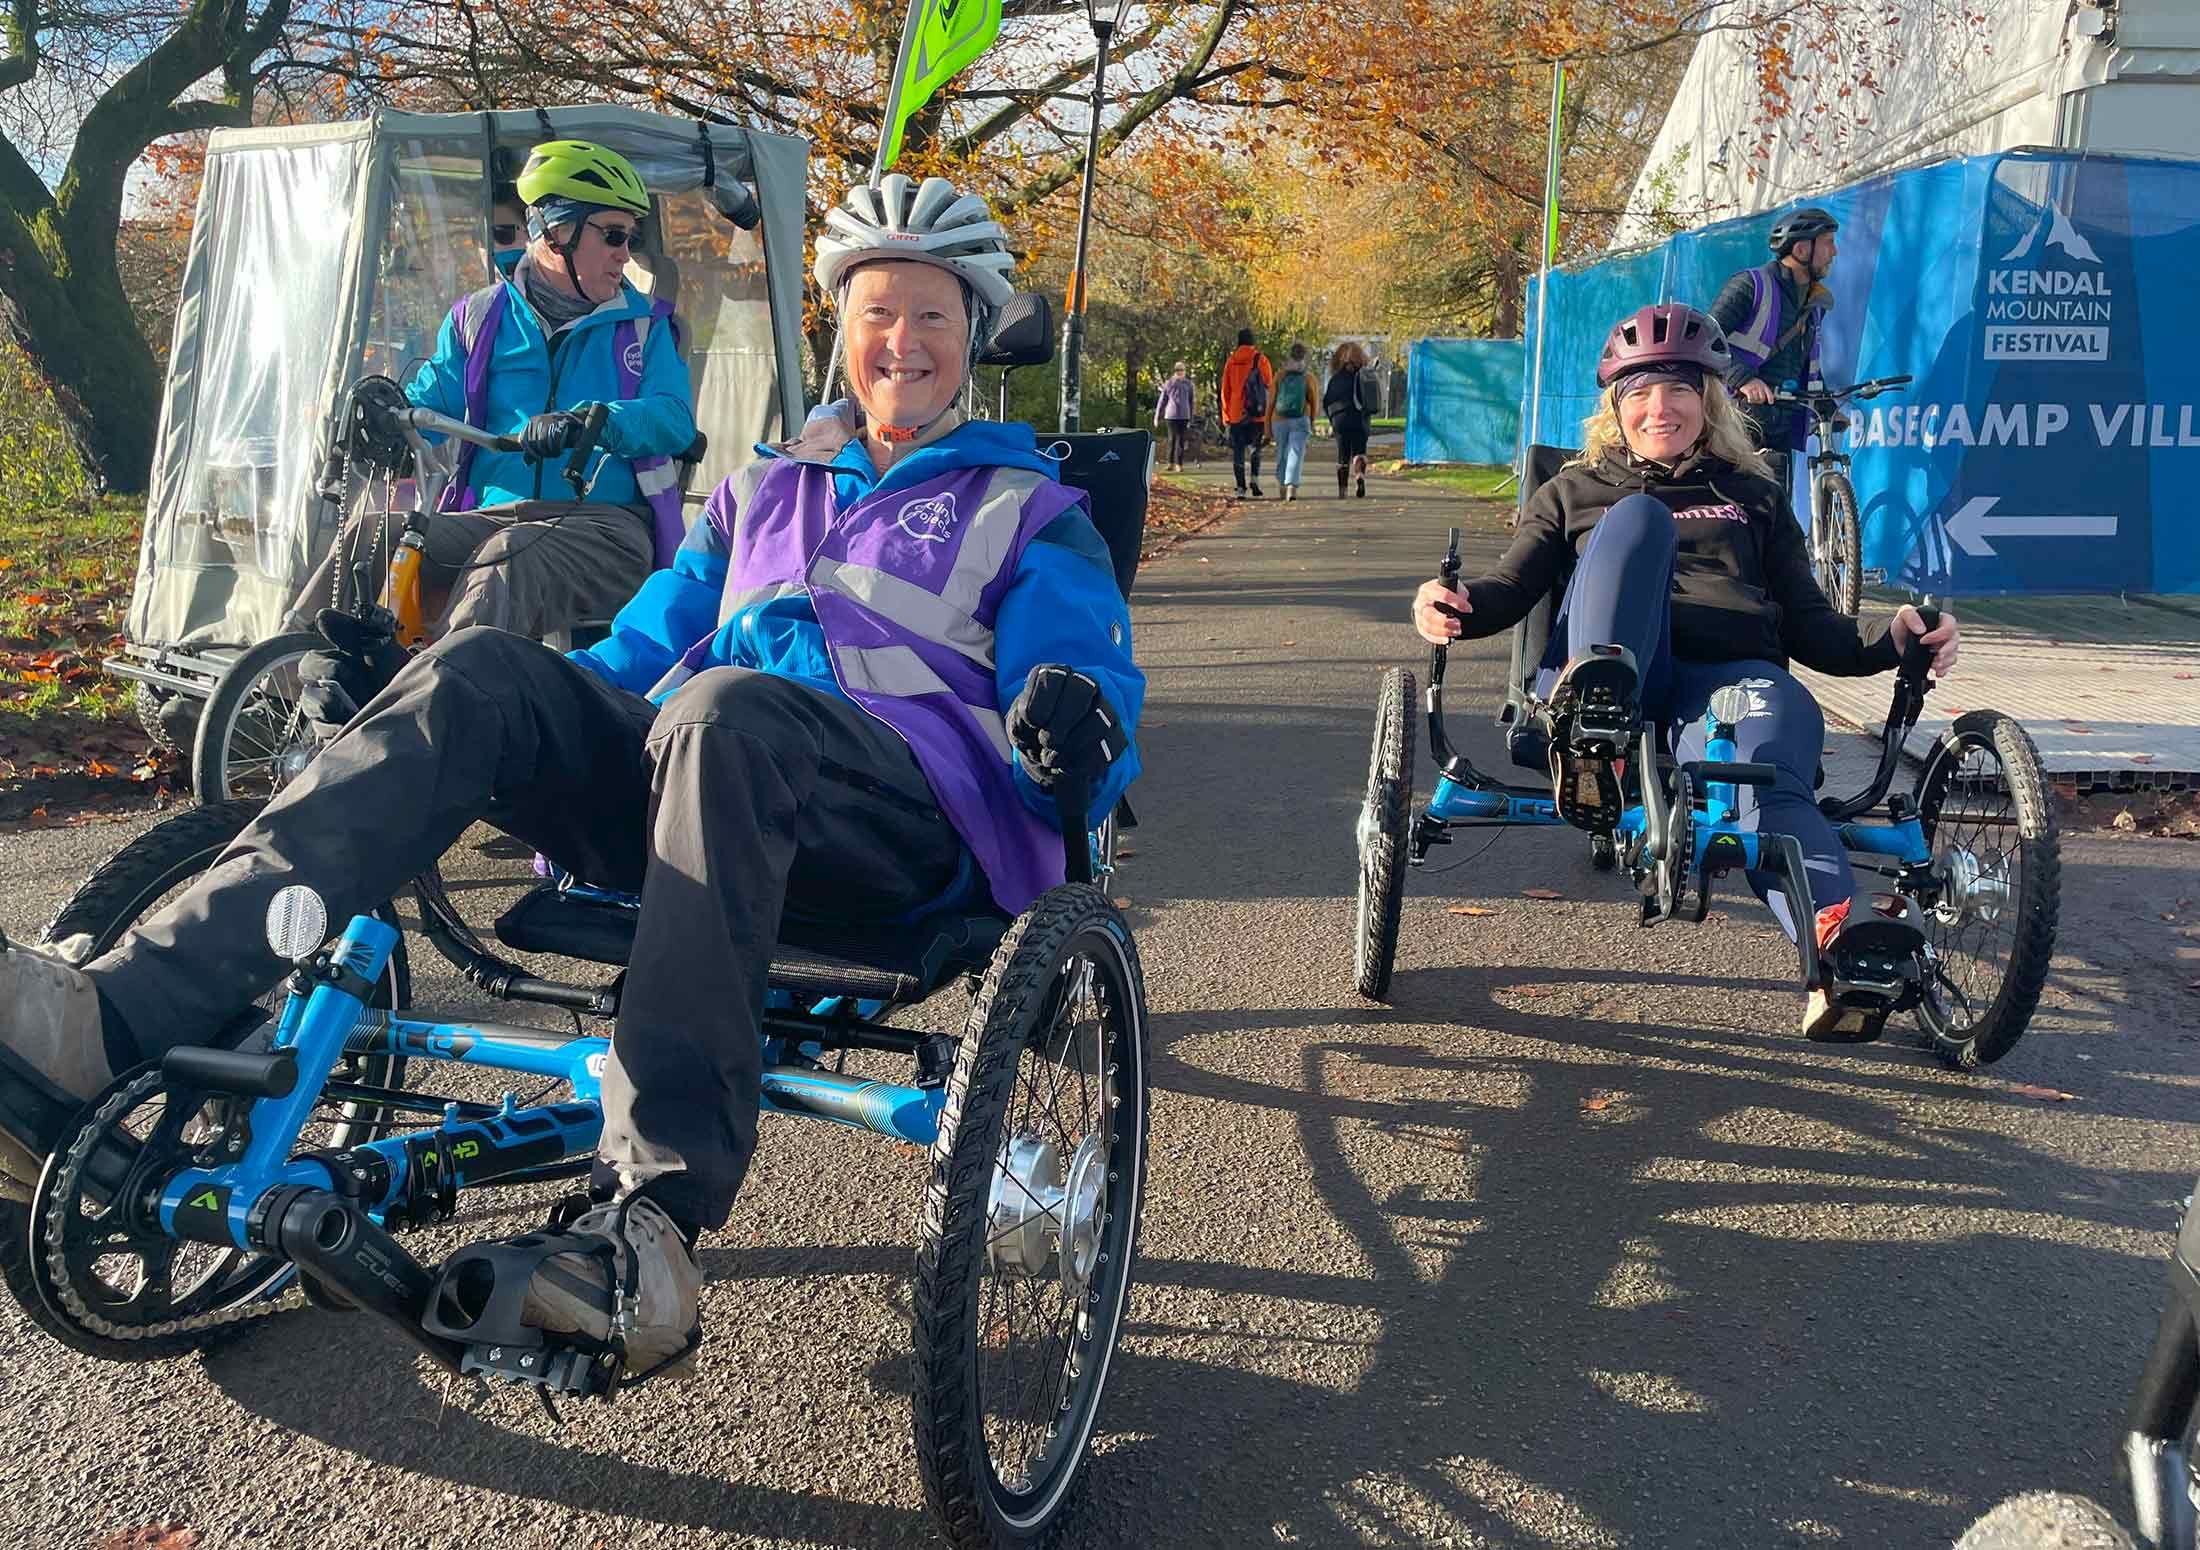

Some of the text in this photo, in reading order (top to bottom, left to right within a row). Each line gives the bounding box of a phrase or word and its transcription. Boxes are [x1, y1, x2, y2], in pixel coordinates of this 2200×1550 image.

[1988, 270, 2112, 296] KENDAL
[1986, 300, 2111, 321] MOUNTAIN
[1991, 332, 2101, 353] FESTIVAL
[1849, 403, 2200, 451] BASECAMP VILL
